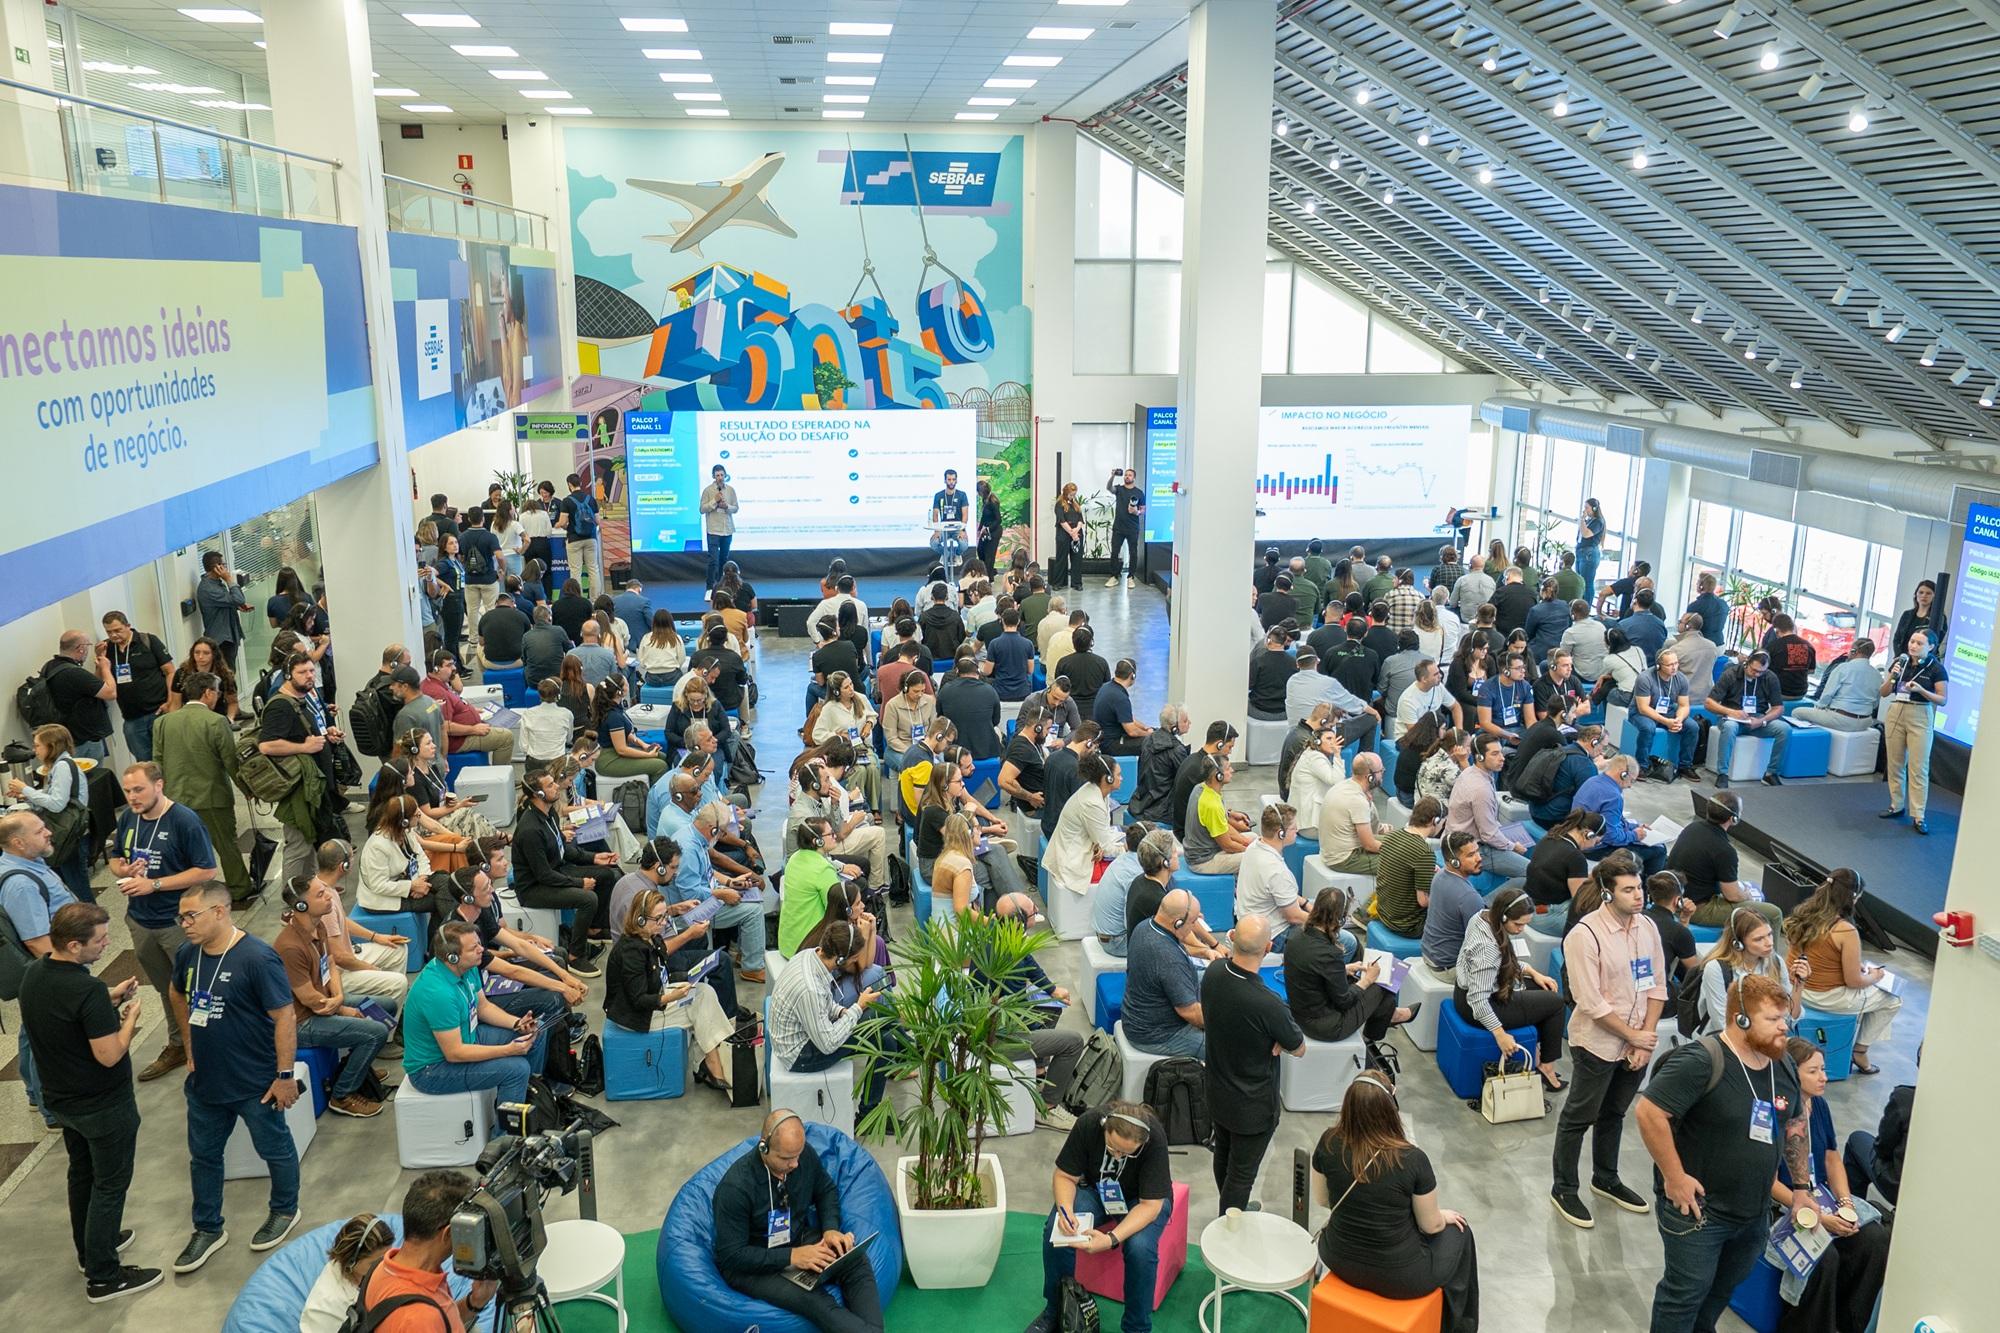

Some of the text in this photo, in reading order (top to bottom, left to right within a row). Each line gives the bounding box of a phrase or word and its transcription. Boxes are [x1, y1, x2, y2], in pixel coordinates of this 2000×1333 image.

[928, 172, 986, 186] SEBRAE
[160, 305, 231, 359] ideias
[424, 339, 444, 357] SEBRAE
[37, 366, 216, 430] com oportunidades
[1281, 410, 1388, 420] IMPACTO NO NEGÓCIO
[531, 422, 573, 431] INFORMAÇÕES
[720, 420, 871, 430] RESULTADO ESPERADO NA
[720, 431, 849, 442] SOLUÇÃO DO DESAFIO
[84, 417, 188, 472] de negócio.
[1975, 514, 2000, 527] PALCO
[1973, 526, 2000, 539] CANAL
